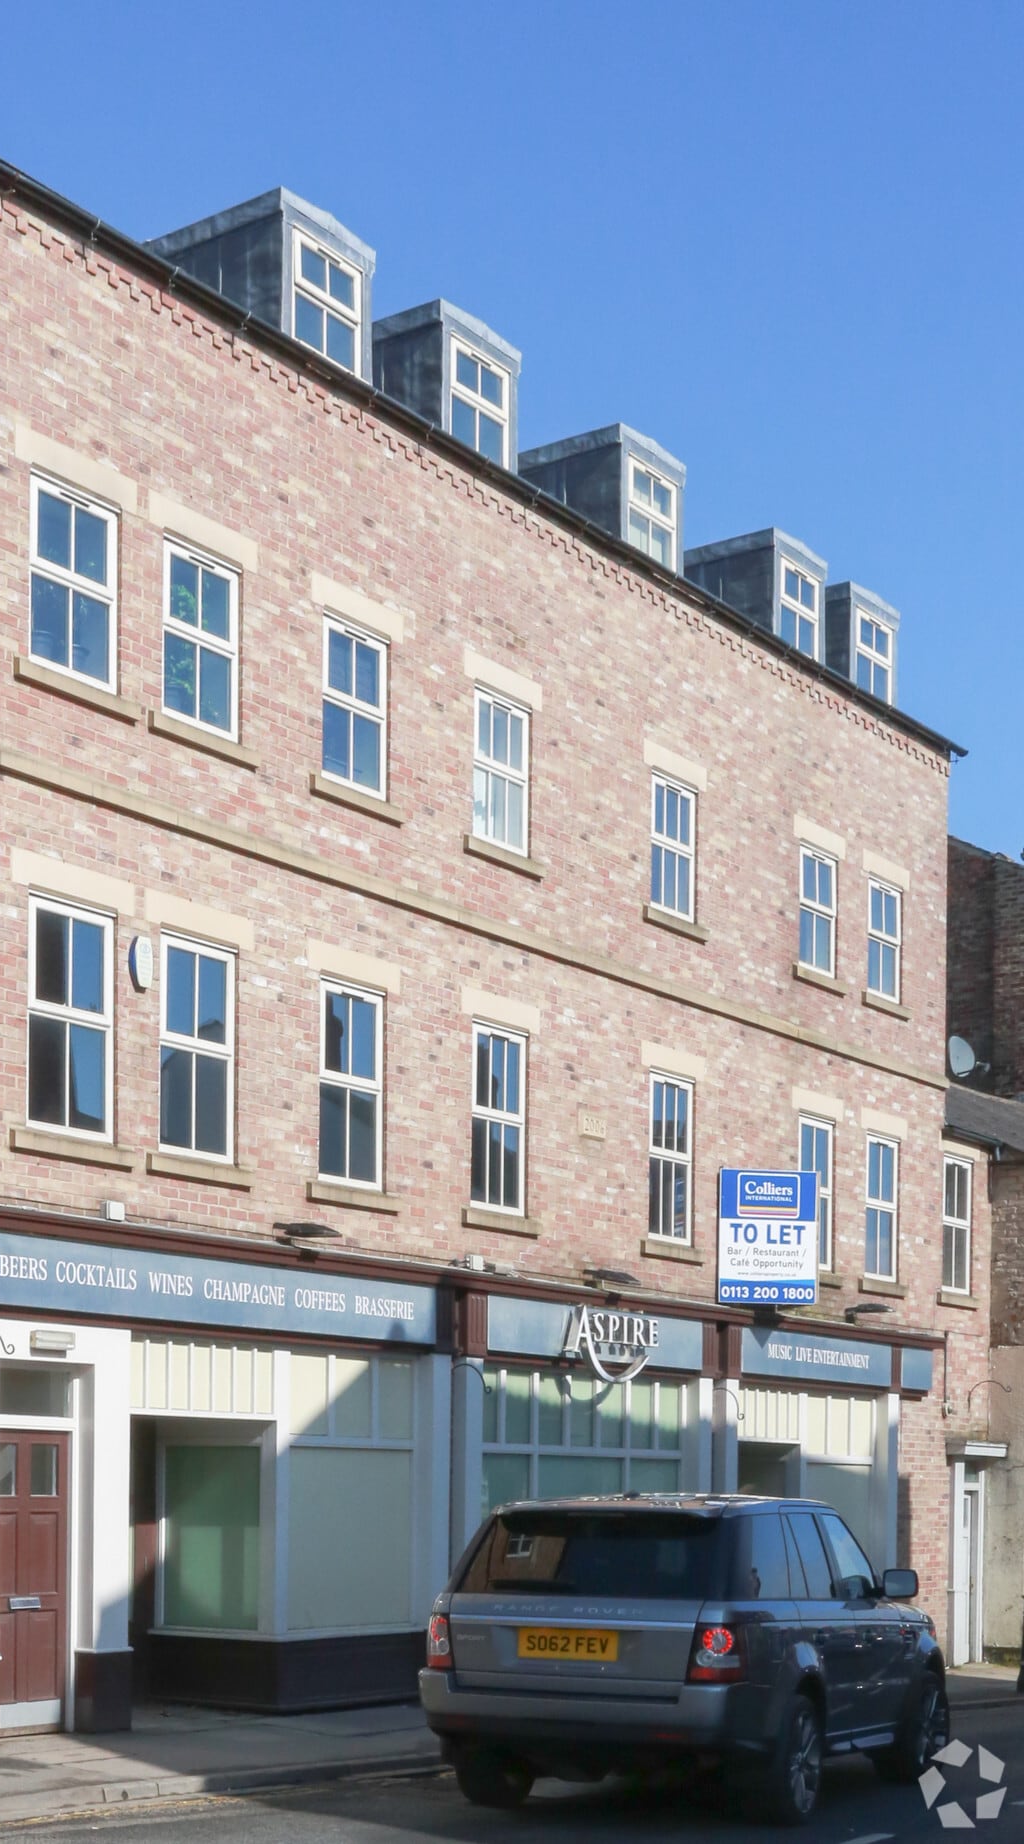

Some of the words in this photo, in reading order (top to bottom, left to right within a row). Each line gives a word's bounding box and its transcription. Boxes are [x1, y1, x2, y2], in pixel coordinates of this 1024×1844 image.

[745, 1181, 793, 1196] Colliers
[730, 1223, 758, 1243] TO
[767, 1224, 806, 1245] LET
[727, 1247, 742, 1255] Bar
[753, 1247, 799, 1257] Restaurant
[730, 1258, 750, 1266] Café
[753, 1259, 803, 1269] Opportunity
[0, 1254, 47, 1280] BEERS
[55, 1260, 137, 1290] COCKTAILS
[149, 1271, 193, 1297] WINES
[203, 1278, 285, 1306] CHAMPAGNE
[294, 1288, 346, 1312] COFFEES
[355, 1295, 414, 1320] BRASSERIE
[721, 1286, 749, 1298] 0113
[754, 1287, 779, 1299] 200
[783, 1287, 813, 1299] 1800
[572, 1304, 659, 1381] ASPIRE
[768, 1343, 792, 1360] MUSIC
[796, 1346, 812, 1363] LIVE
[813, 1348, 870, 1369] ENTERTAINMENT
[527, 1635, 570, 1652] SO62
[575, 1637, 609, 1653] FEV
